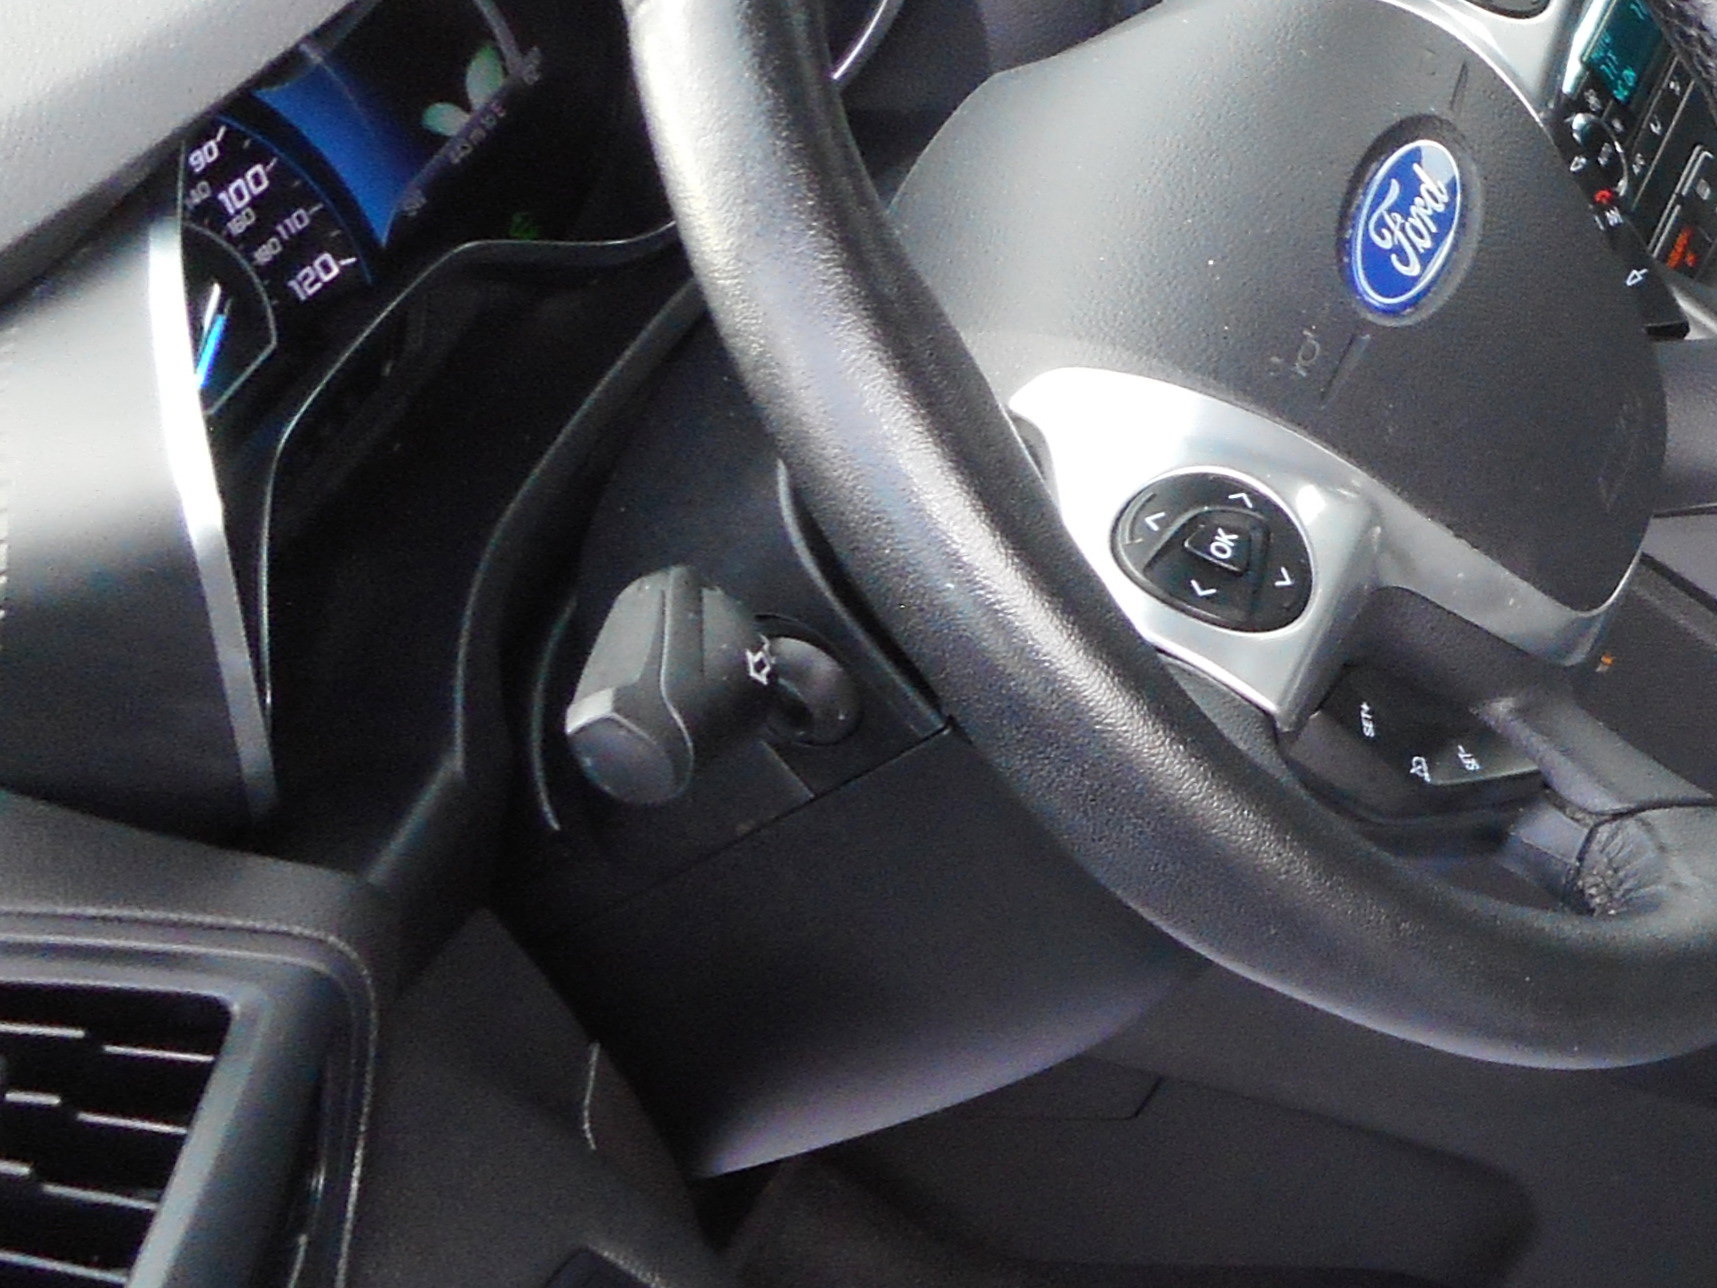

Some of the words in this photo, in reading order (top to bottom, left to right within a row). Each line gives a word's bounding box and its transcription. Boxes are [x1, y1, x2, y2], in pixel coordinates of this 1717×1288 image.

[188, 139, 219, 174] 90
[217, 163, 270, 216] 100
[276, 208, 311, 240] 110
[1368, 162, 1450, 277] Ford
[287, 252, 341, 301] 120
[1210, 527, 1239, 559] OK
